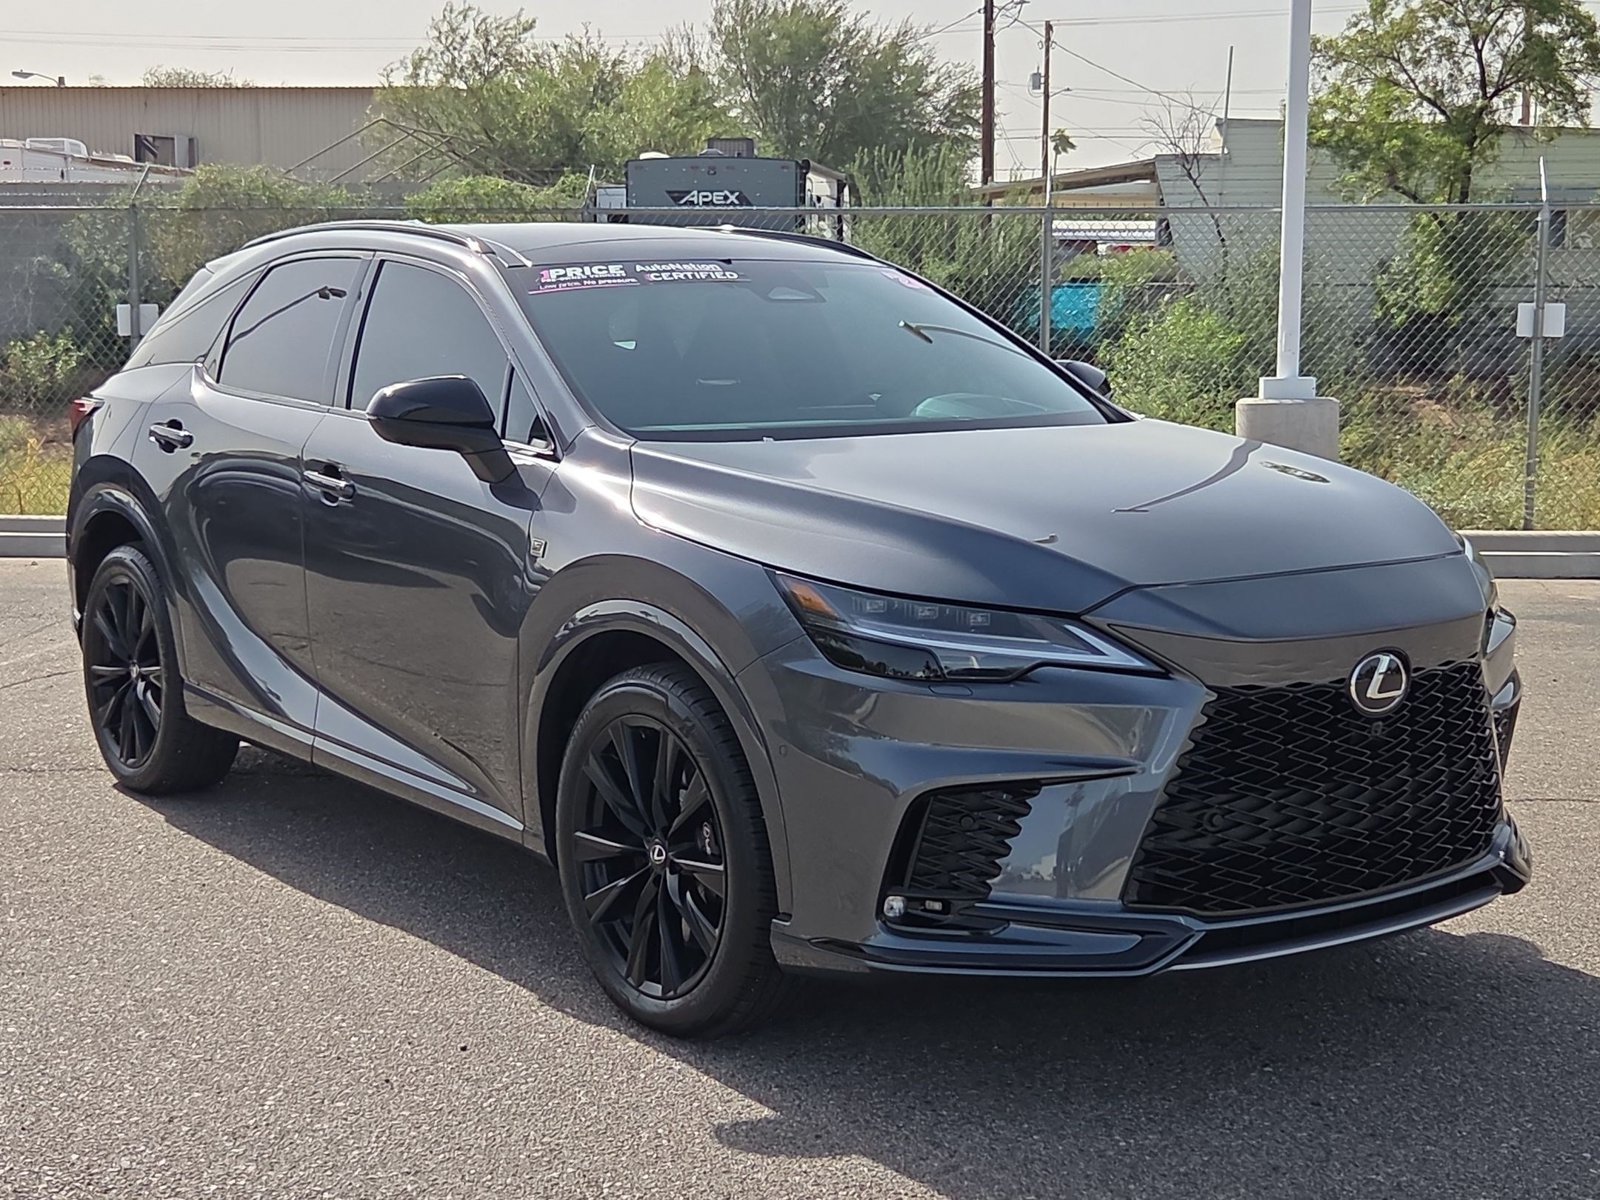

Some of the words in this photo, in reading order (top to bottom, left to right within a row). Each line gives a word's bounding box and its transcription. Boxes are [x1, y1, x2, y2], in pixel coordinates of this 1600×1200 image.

[678, 190, 740, 206] APEX
[635, 263, 722, 272] AutoNation
[650, 271, 739, 281] CERTIFIED
